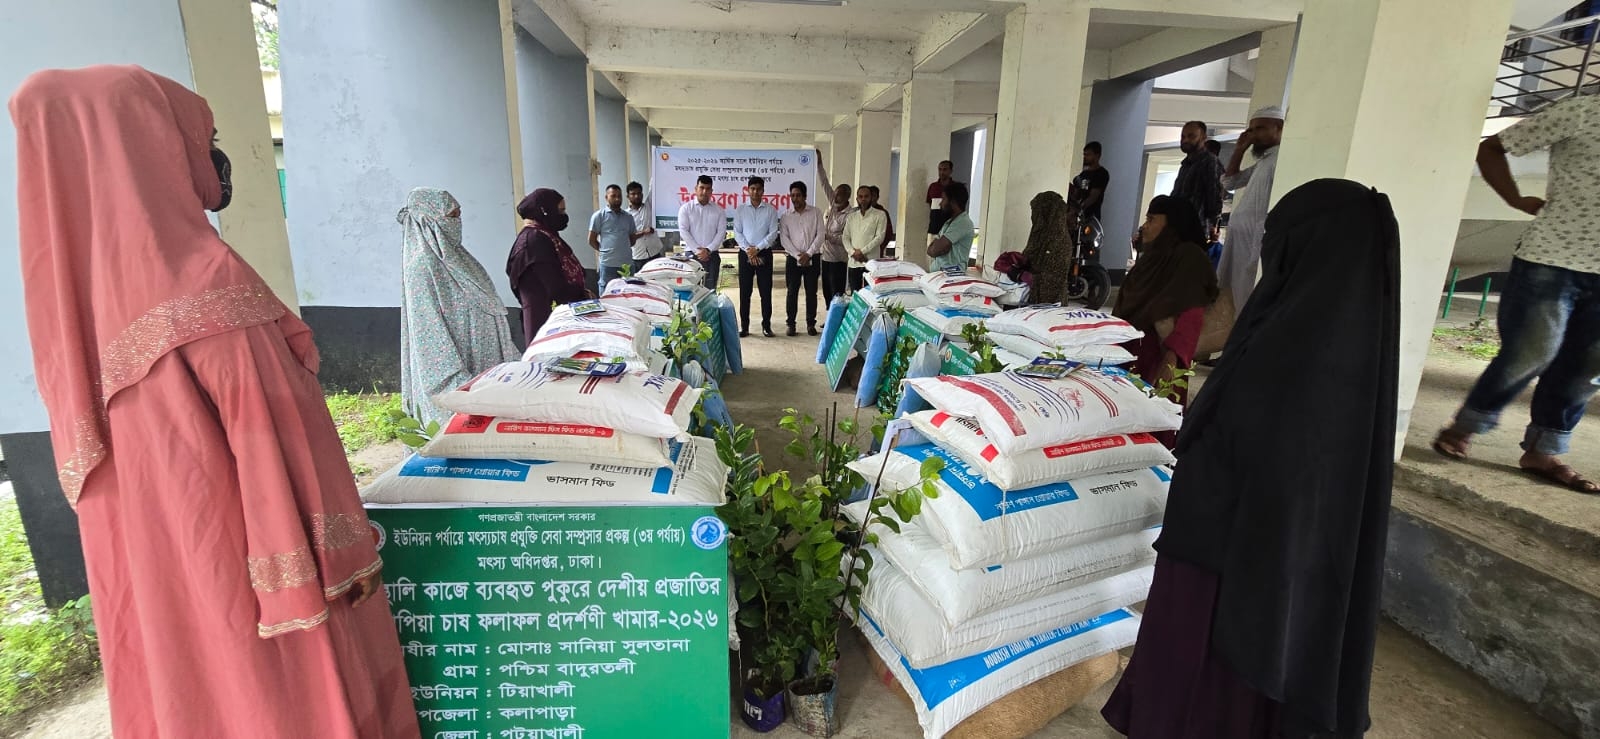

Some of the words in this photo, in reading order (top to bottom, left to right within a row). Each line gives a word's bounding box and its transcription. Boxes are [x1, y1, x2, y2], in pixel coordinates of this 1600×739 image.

[424, 465, 447, 475] নারিশ
[502, 468, 521, 478] ফিড
[546, 475, 588, 487] ভাসমান
[592, 476, 617, 489] ফিড
[1089, 482, 1121, 496] ভাসমান
[1120, 479, 1138, 491] ফিড
[526, 512, 566, 522] বাংলাদেশ
[567, 512, 596, 521] সরকার
[392, 527, 432, 547] ইউনিয়ন
[434, 526, 464, 546] পর্যায়ে
[467, 530, 508, 546] মৎস্যচাষ
[510, 526, 539, 549] প্রযুক্তি
[541, 529, 563, 545] সেবা
[605, 529, 631, 545] প্রকল্প
[633, 527, 654, 547] (৩য়
[656, 523, 686, 548] পর্যায়)
[477, 556, 508, 570] মৎস্য
[422, 580, 471, 601] কাজে
[474, 580, 537, 602] ব্যবহৃত
[541, 578, 594, 604] পুকুরে
[597, 571, 651, 598] দেশীয়
[654, 571, 723, 598] প্রজাতির
[440, 612, 471, 633] চাষ
[476, 612, 542, 632] ফলাফল
[612, 608, 719, 631] খামার-২০২৬
[443, 643, 478, 657] নাম
[498, 641, 552, 656] মোসাঃ
[558, 637, 617, 654] সানিয়া
[621, 638, 691, 656] সুলতানা
[983, 648, 1011, 669] NOURISH
[442, 664, 478, 678] গ্রাম
[499, 660, 551, 677] পশ্চিম
[556, 658, 637, 679] বাদুরতলী
[497, 681, 576, 699] টিয়াখালী
[498, 705, 577, 721] কলাপাড়া
